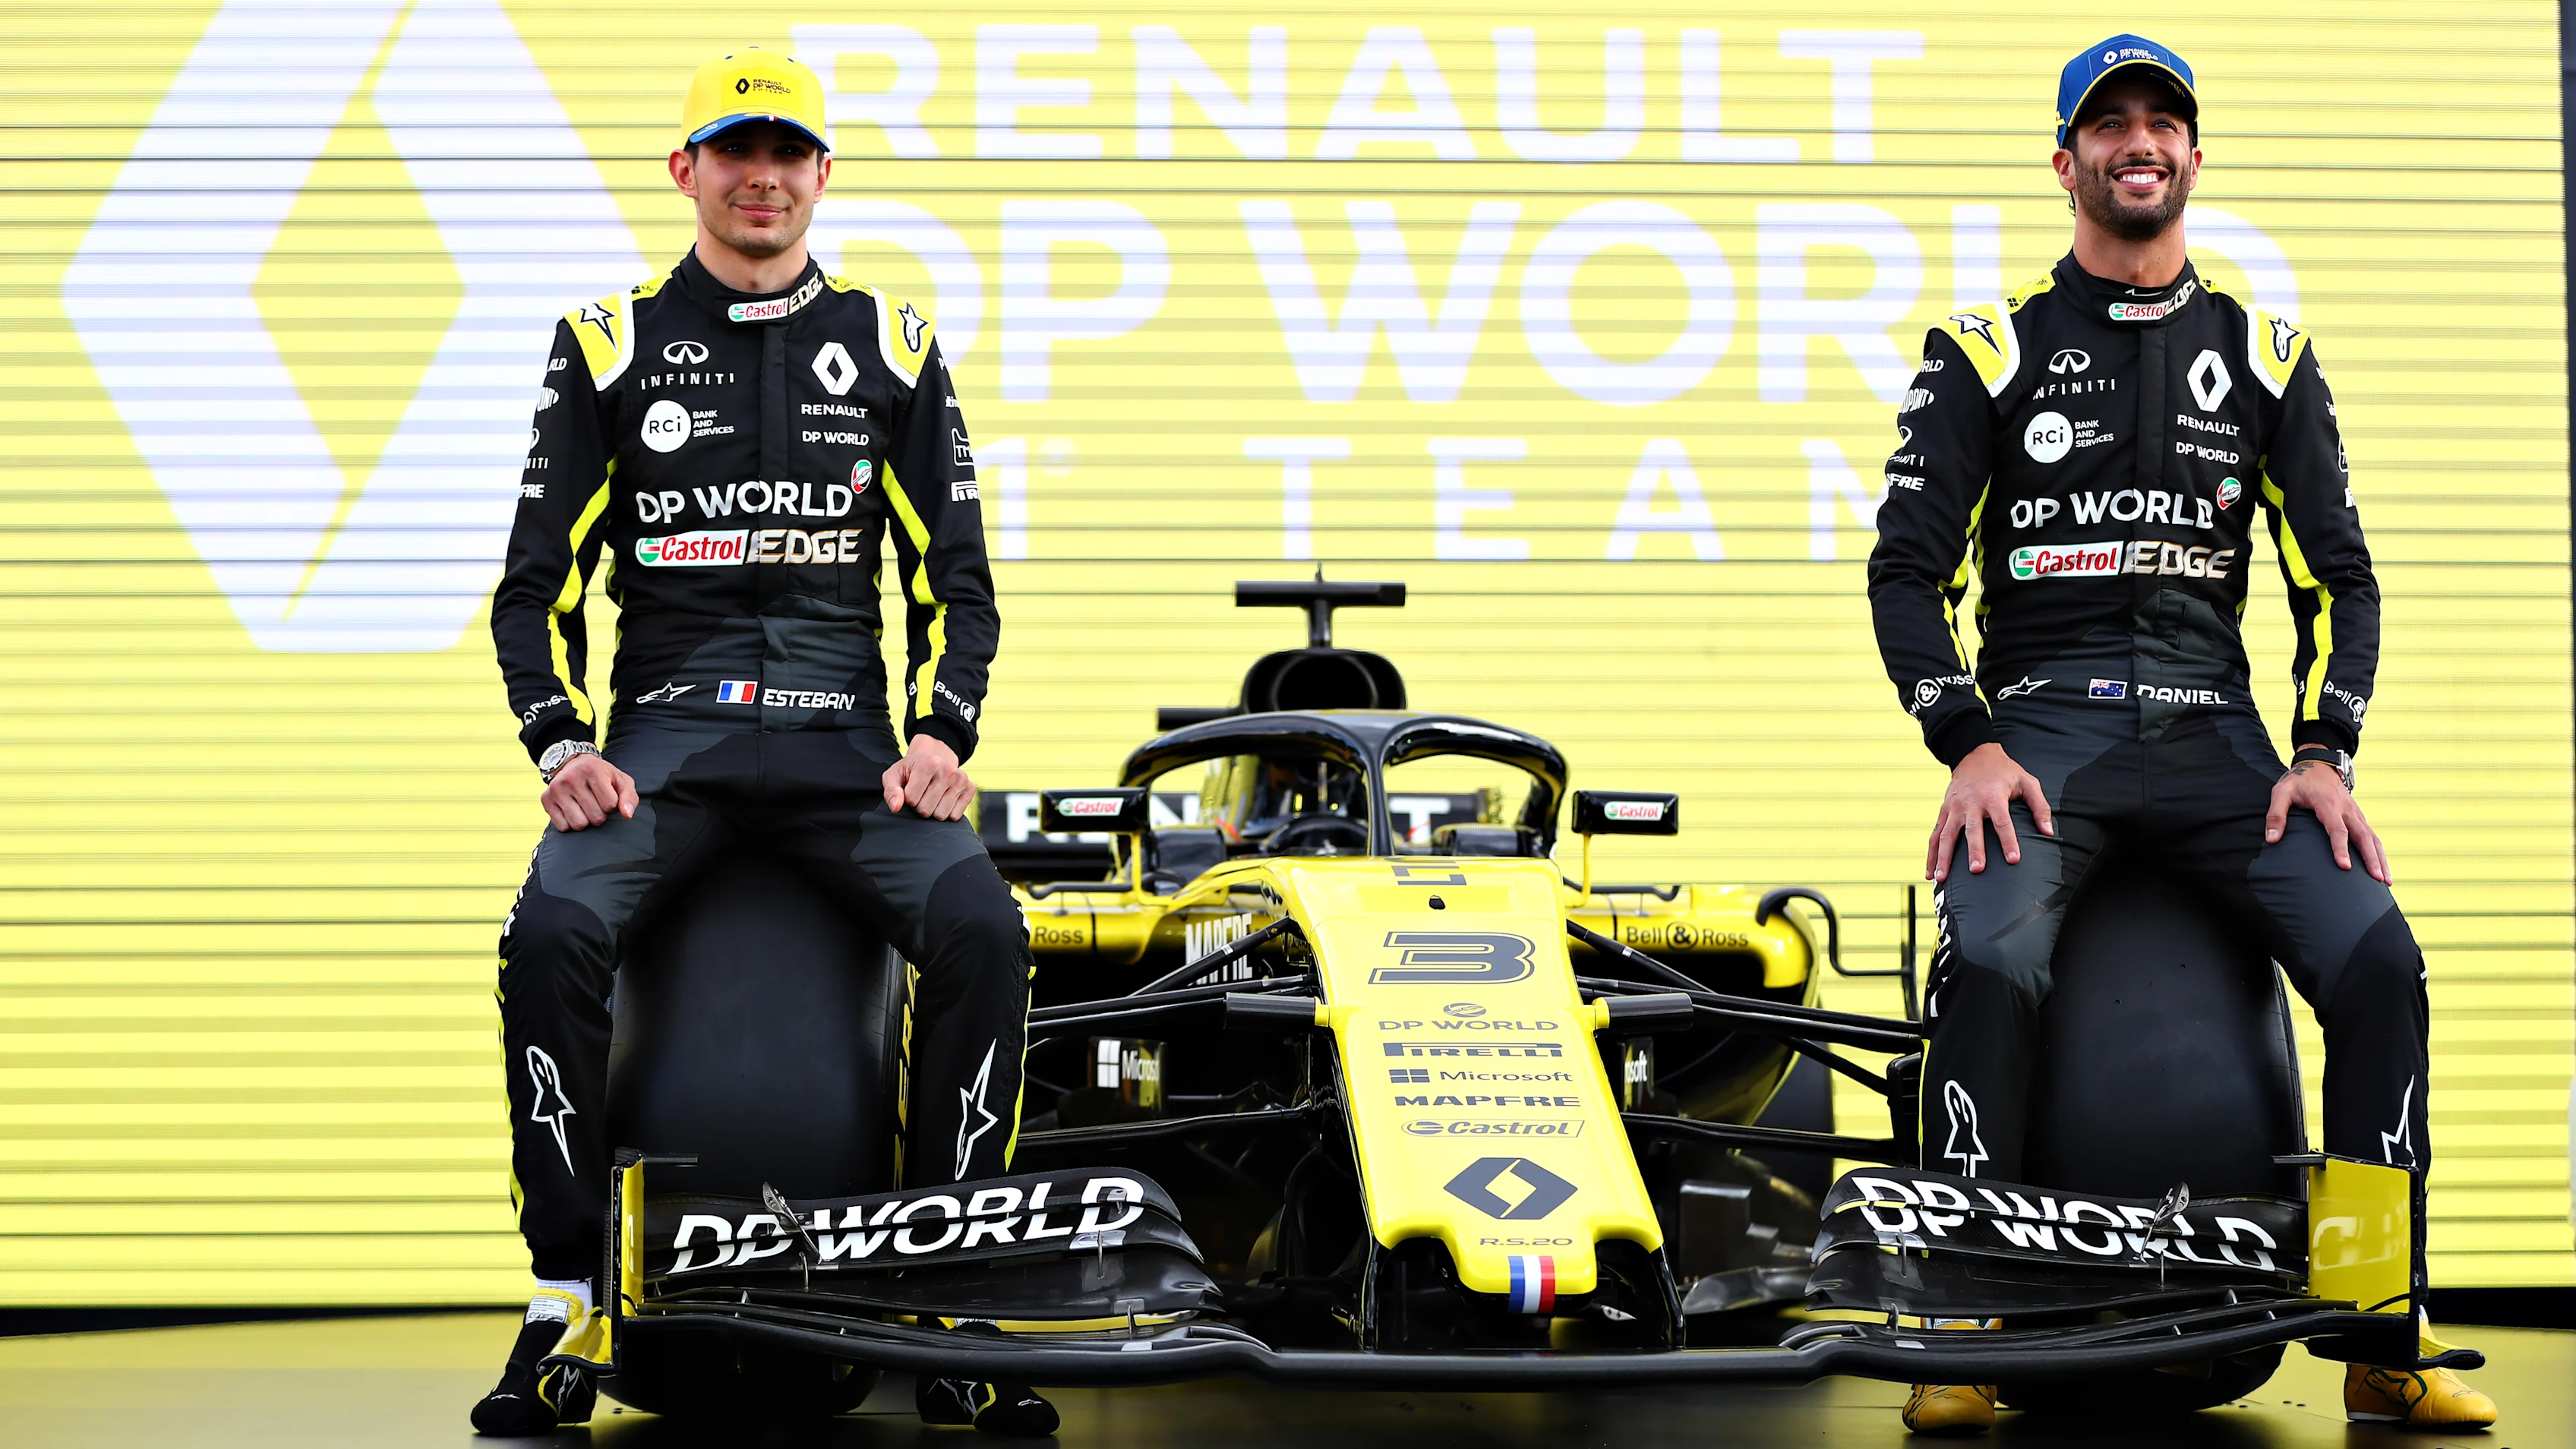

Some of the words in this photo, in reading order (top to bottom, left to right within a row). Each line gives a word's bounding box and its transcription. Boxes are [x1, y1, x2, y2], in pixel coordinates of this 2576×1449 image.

[765, 84, 791, 93] WORLD
[790, 23, 1924, 163] RENAULT
[746, 300, 787, 318] Castrol
[2126, 304, 2167, 317] Castrol
[548, 358, 567, 371] RLD
[1921, 359, 1944, 373] RLD
[641, 373, 734, 390] INFINITI
[693, 410, 718, 418] BANK
[801, 404, 868, 418] RENAULT
[693, 420, 712, 428] AND
[693, 426, 734, 437] SERVICES
[2075, 420, 2099, 429] BANK
[2177, 414, 2240, 437] RENAULT
[802, 431, 821, 443] DP
[823, 432, 869, 446] WORLD
[2076, 430, 2095, 439] AND
[2076, 434, 2114, 447] SERVICES
[2176, 441, 2195, 455] DP
[2196, 445, 2239, 464] WORLD
[636, 491, 685, 523] DP
[692, 480, 853, 519] WORLD
[2011, 498, 2060, 528] DP
[2069, 488, 2214, 529] WORLD
[661, 536, 742, 560] Castrol
[746, 529, 862, 564] EDGE
[2035, 548, 2117, 574] Castrol
[2122, 541, 2237, 579] EDGE
[762, 687, 855, 712] ESTEBAN
[933, 680, 961, 706] Bell
[2136, 683, 2229, 706] DANIEL
[2323, 680, 2352, 705] Bell
[1075, 801, 1118, 814] Castrol
[1619, 805, 1659, 819] Castrol
[1034, 926, 1084, 945] Ross
[1626, 927, 1662, 944] Bell
[1702, 928, 1749, 947] Ross
[1368, 931, 1536, 984] 3
[1378, 1021, 1424, 1031] DP
[1432, 1021, 1559, 1031] WORLD
[1382, 1042, 1563, 1057] PIRELLI
[1440, 1071, 1574, 1082] Microsoft
[1394, 1096, 1581, 1107] MAPFRE
[1447, 1121, 1570, 1135] Castrol
[665, 1214, 792, 1275] DP
[814, 1177, 1145, 1260] WORLD
[1852, 1176, 1975, 1237] DP
[1975, 1188, 2277, 1271] WORLD
[1479, 1237, 1573, 1246] R.S.20
